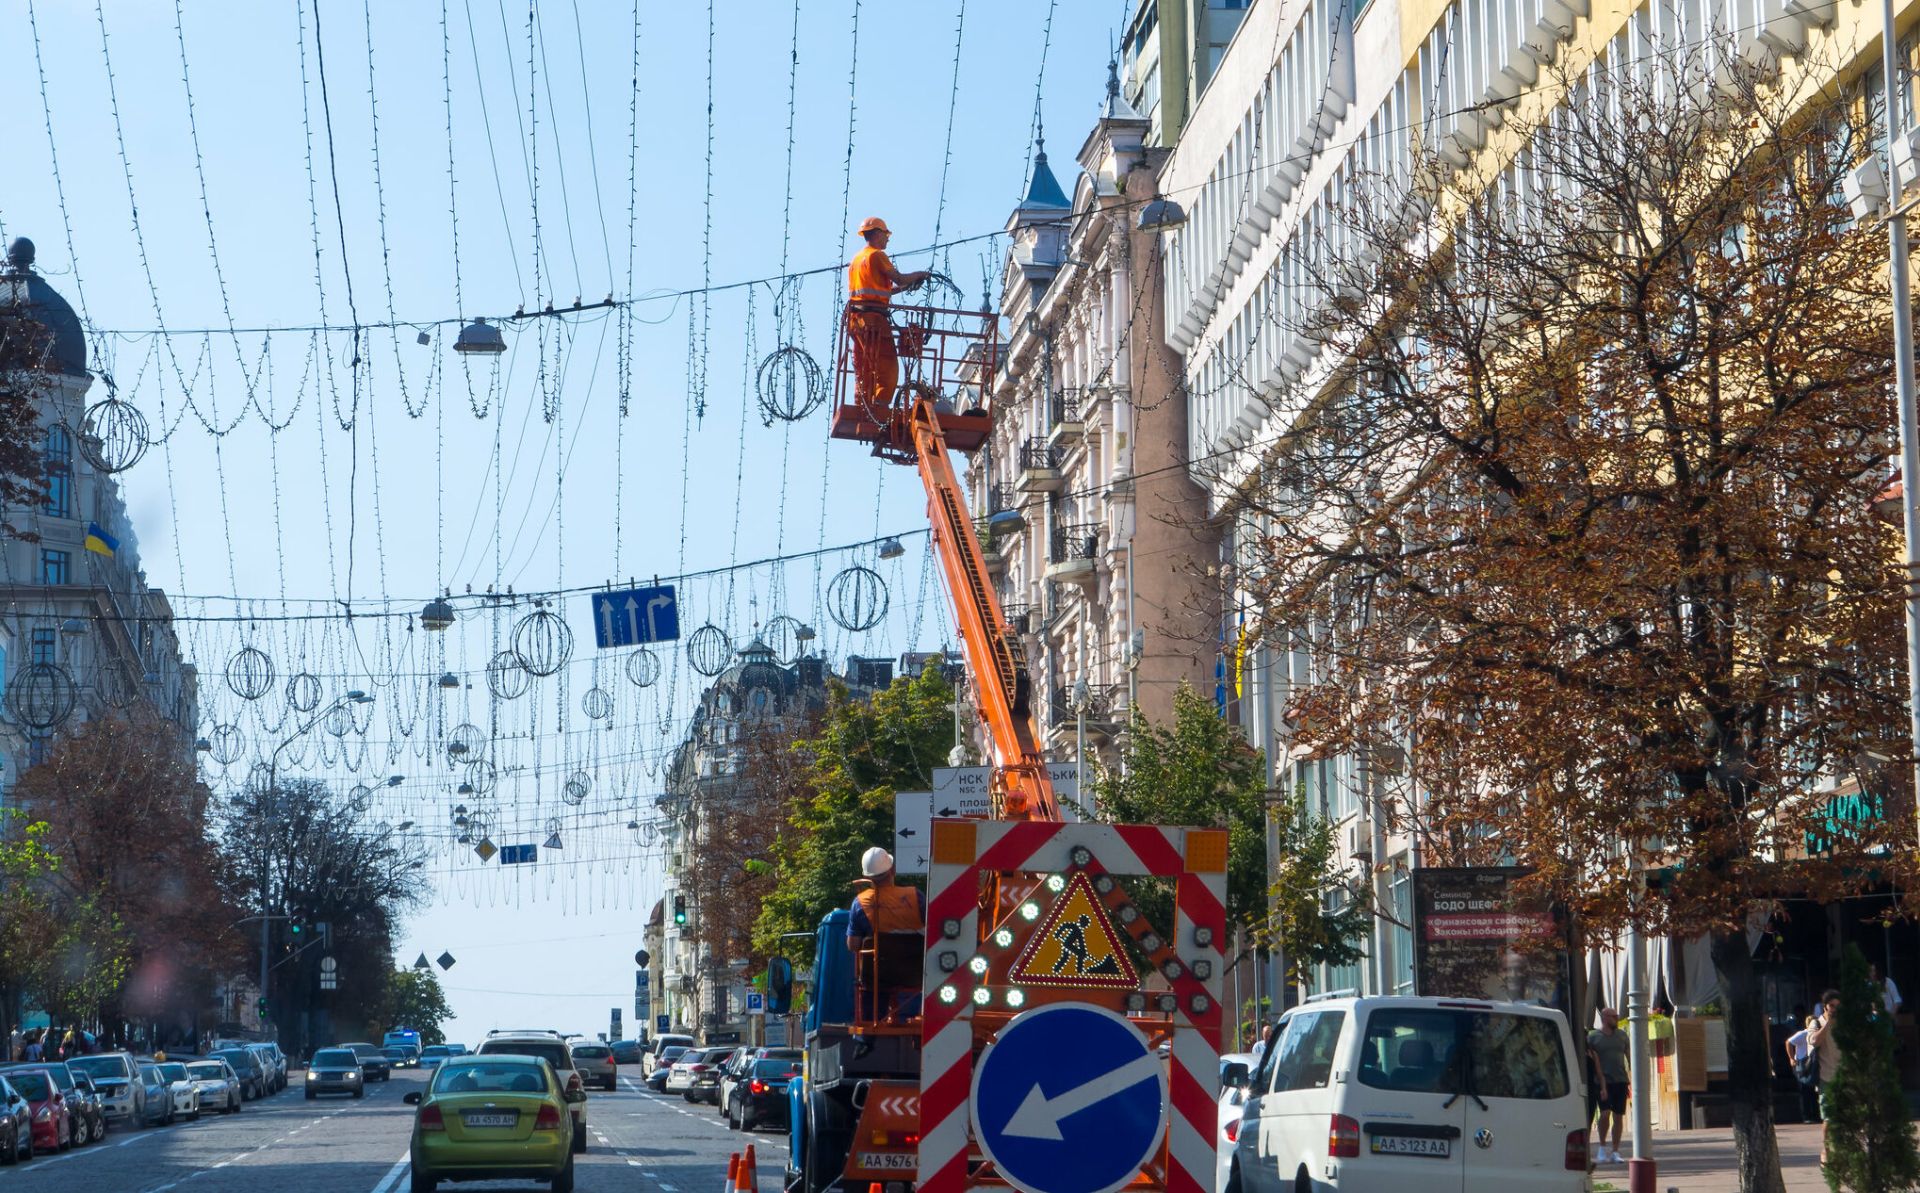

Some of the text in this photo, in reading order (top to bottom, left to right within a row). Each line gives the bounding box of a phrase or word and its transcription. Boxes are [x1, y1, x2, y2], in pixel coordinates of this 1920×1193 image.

[959, 774, 983, 785] НСК
[959, 786, 976, 794] NSC
[1433, 891, 1472, 899] Семинар
[1434, 901, 1466, 911] БОДО
[1434, 927, 1472, 936] Законы
[751, 996, 759, 1007] P
[1380, 1138, 1446, 1153] AA 5123 AA
[865, 1155, 881, 1167] AA
[885, 1155, 912, 1168] 9676
